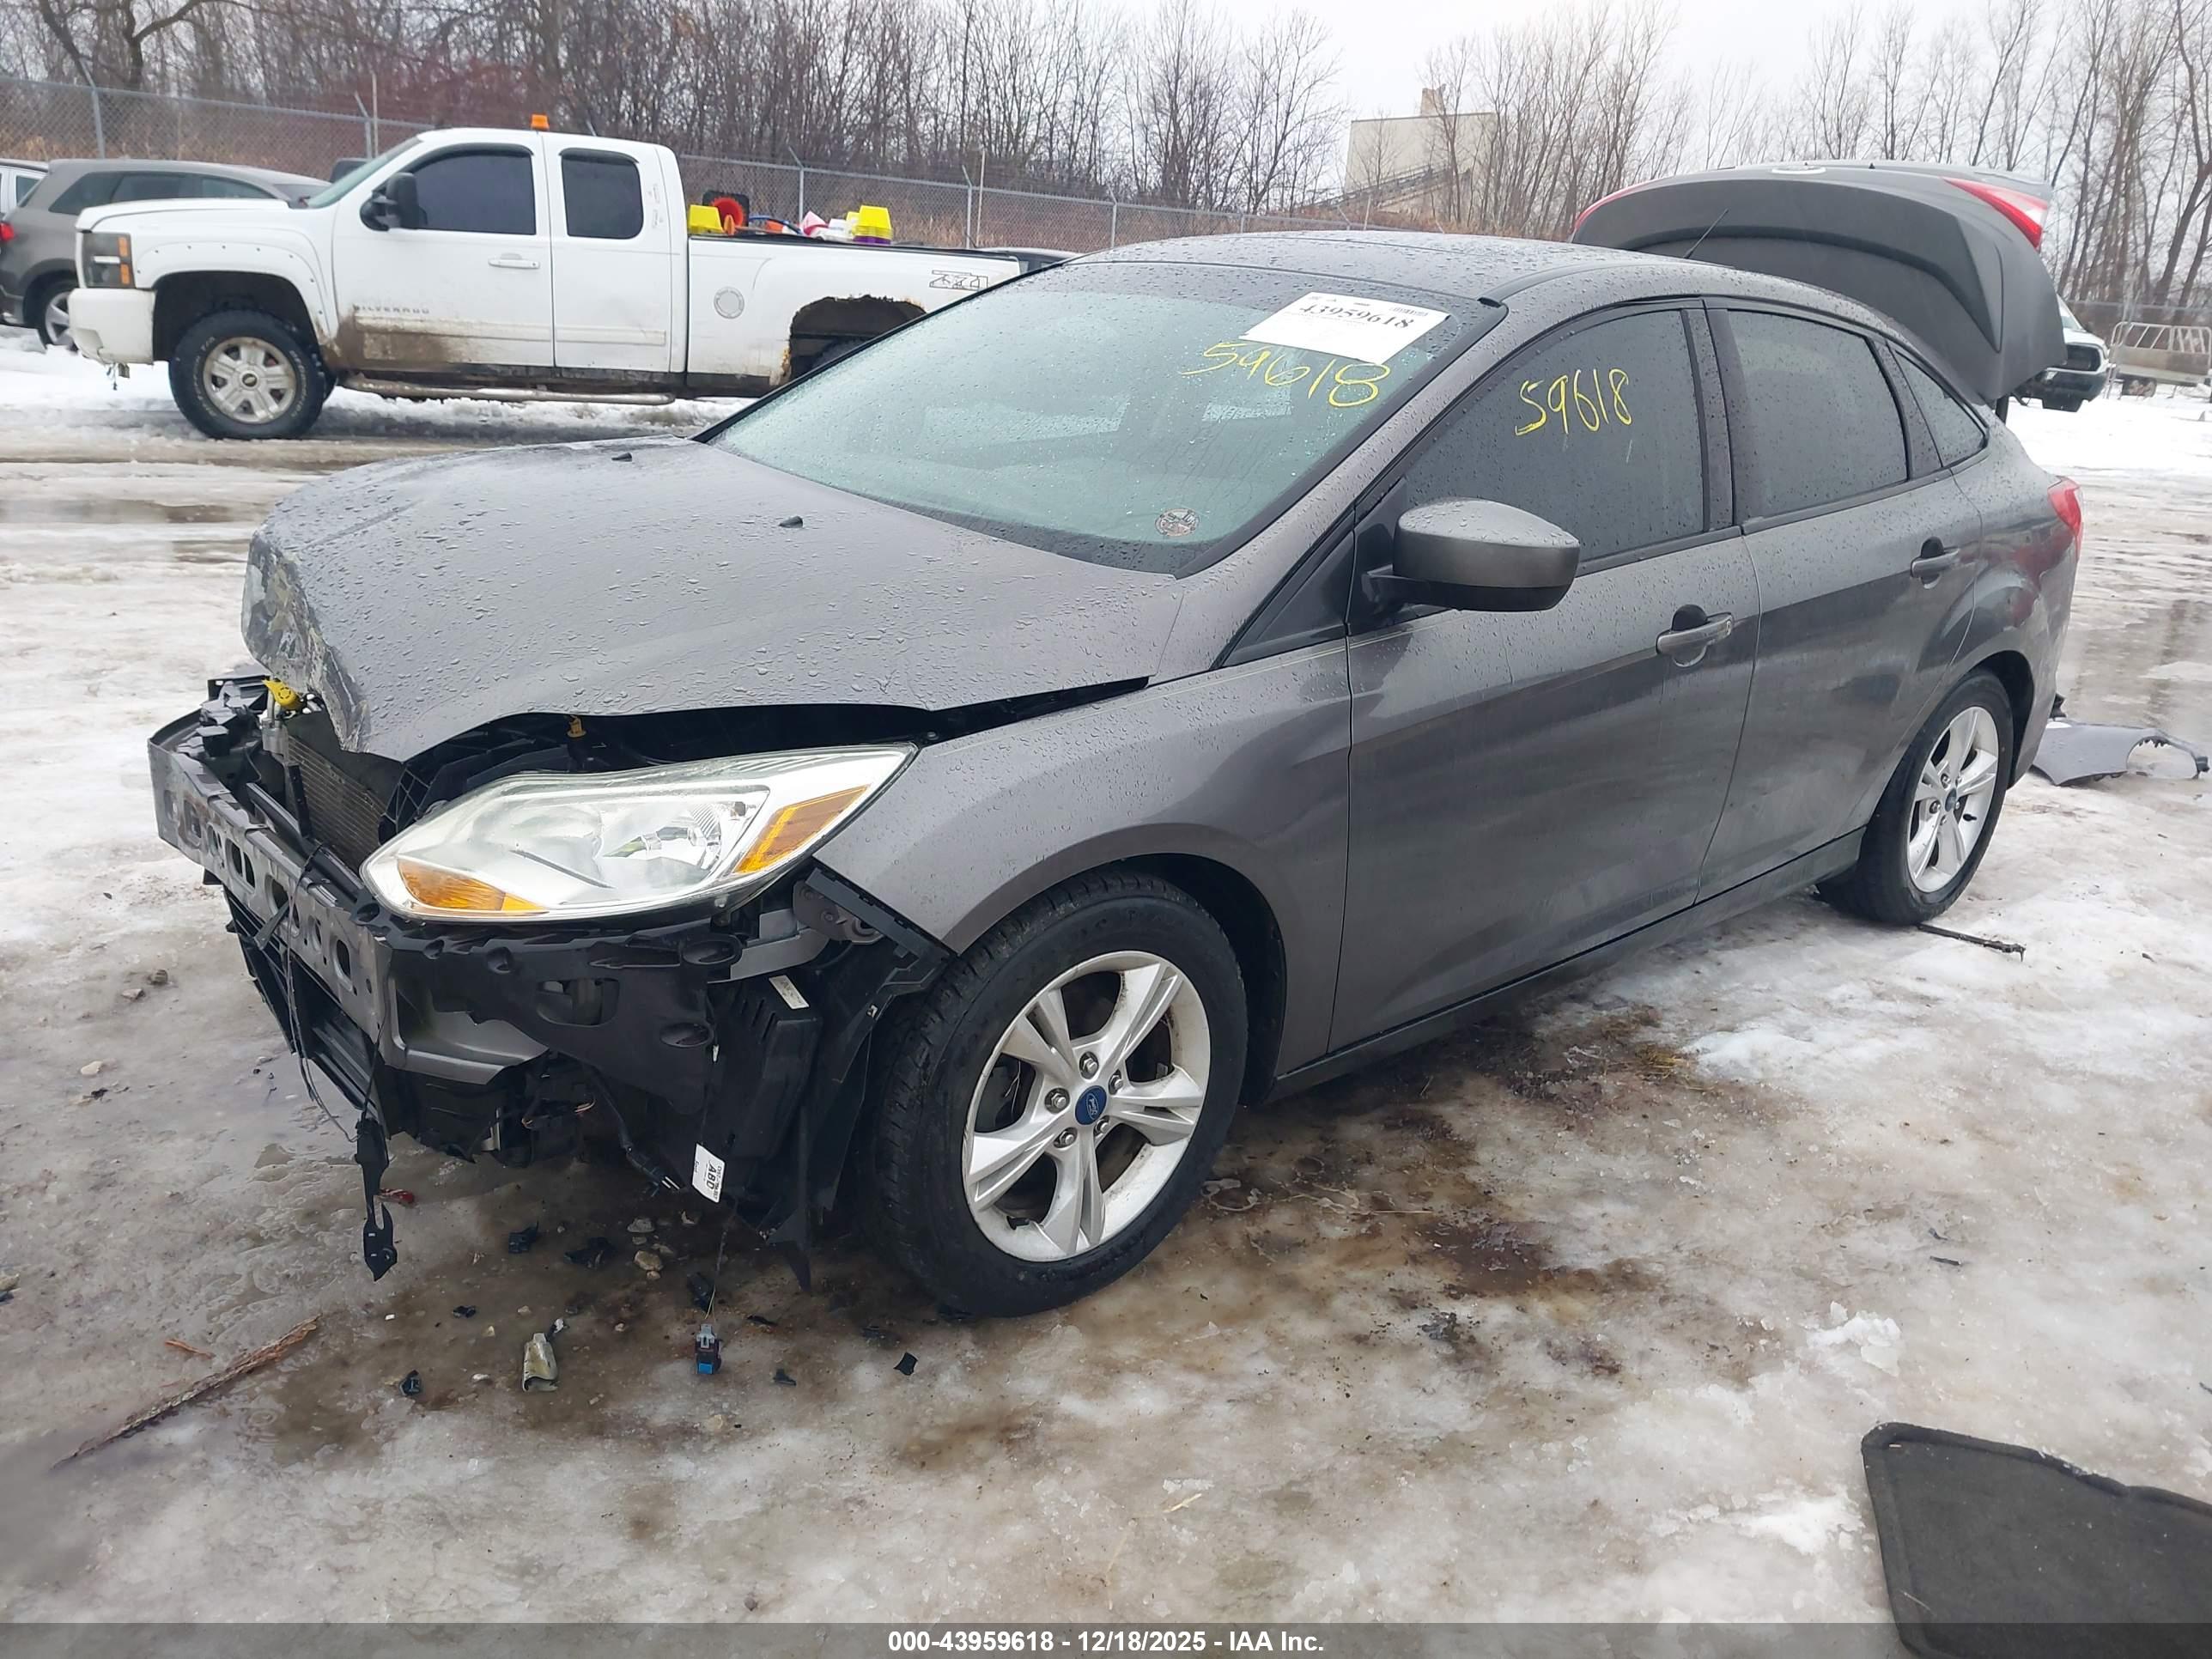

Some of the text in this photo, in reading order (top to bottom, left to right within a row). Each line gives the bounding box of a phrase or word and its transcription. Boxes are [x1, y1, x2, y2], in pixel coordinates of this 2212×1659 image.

[1298, 303, 1415, 329] 43959618
[1181, 341, 1391, 408] 59618
[1515, 368, 1632, 436] 59618
